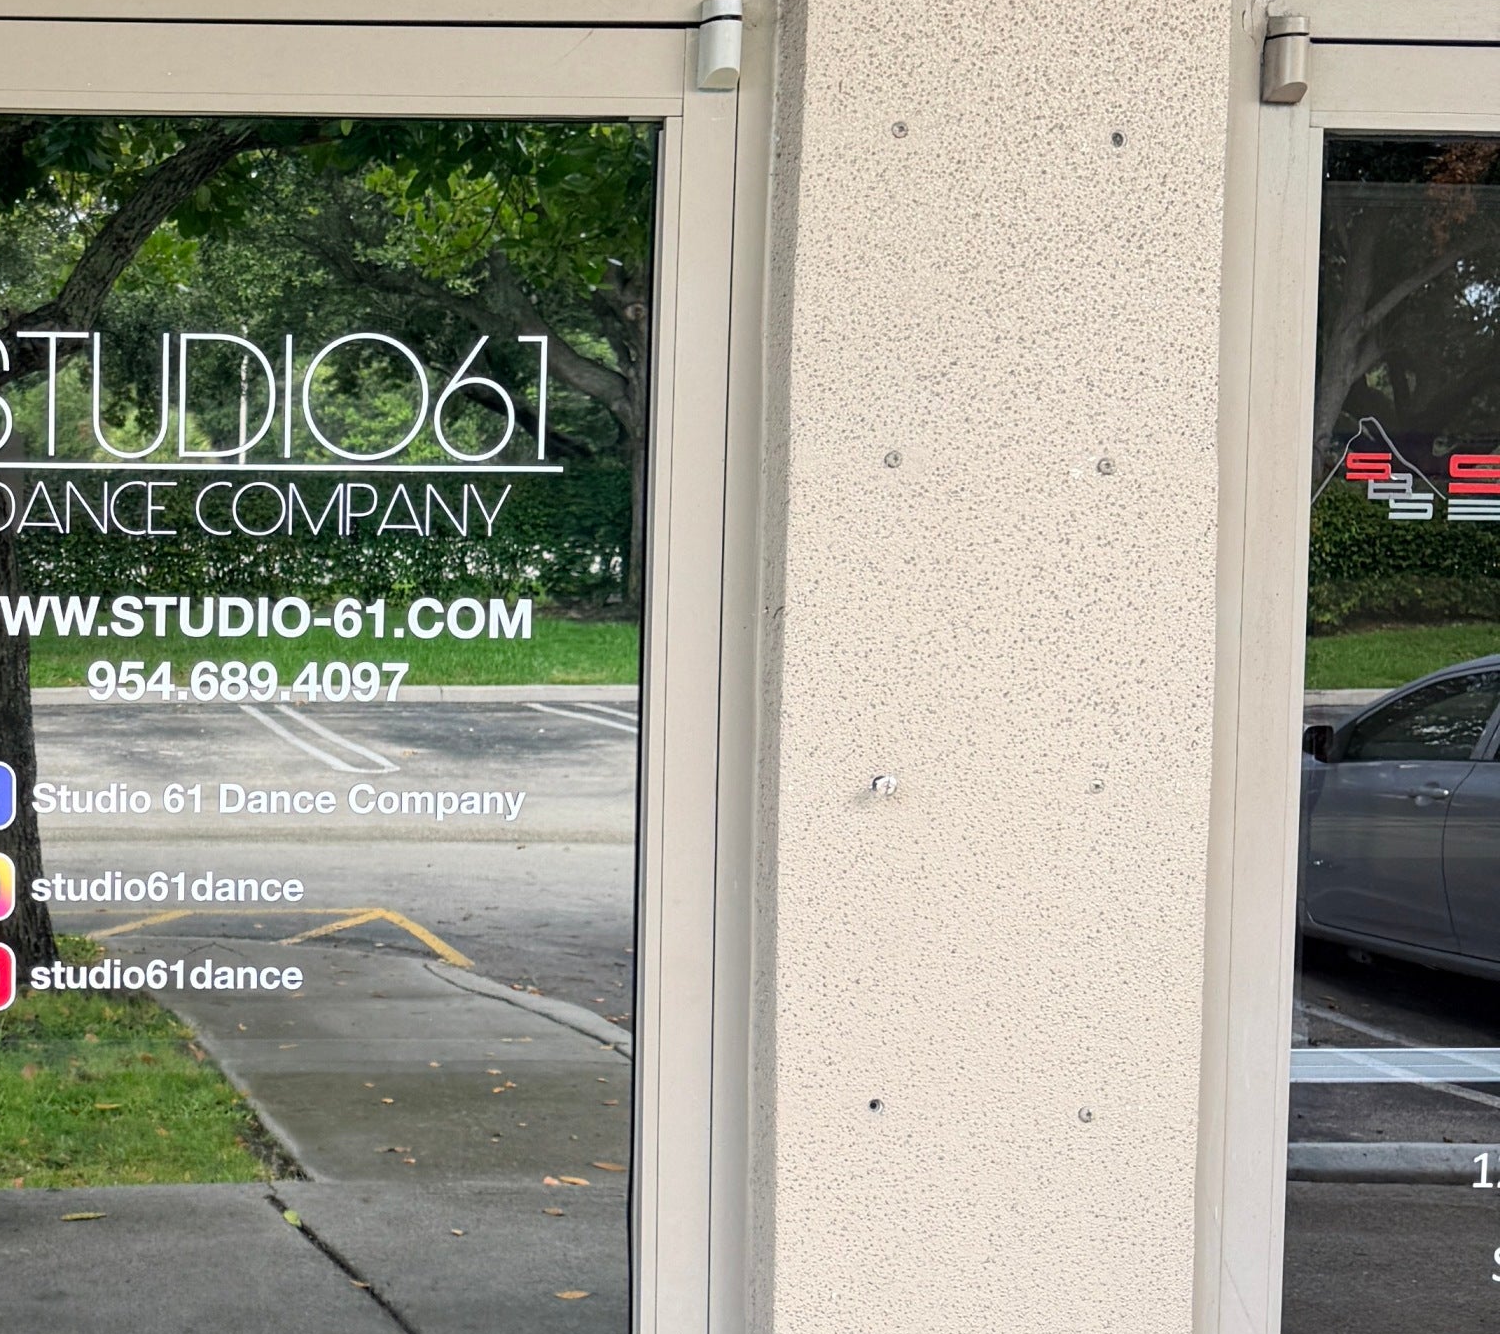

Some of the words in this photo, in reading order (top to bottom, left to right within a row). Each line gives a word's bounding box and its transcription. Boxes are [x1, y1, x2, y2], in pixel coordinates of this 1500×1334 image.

[196, 481, 513, 538] COMPANY
[86, 660, 409, 704] 954.689.4097
[31, 782, 152, 816] Studio
[163, 784, 203, 815] 61
[219, 784, 338, 816] Dance
[347, 783, 527, 823] Company
[31, 870, 306, 904] studio61dance
[30, 959, 305, 993] studio61dance
[1472, 1152, 1500, 1189] 1
